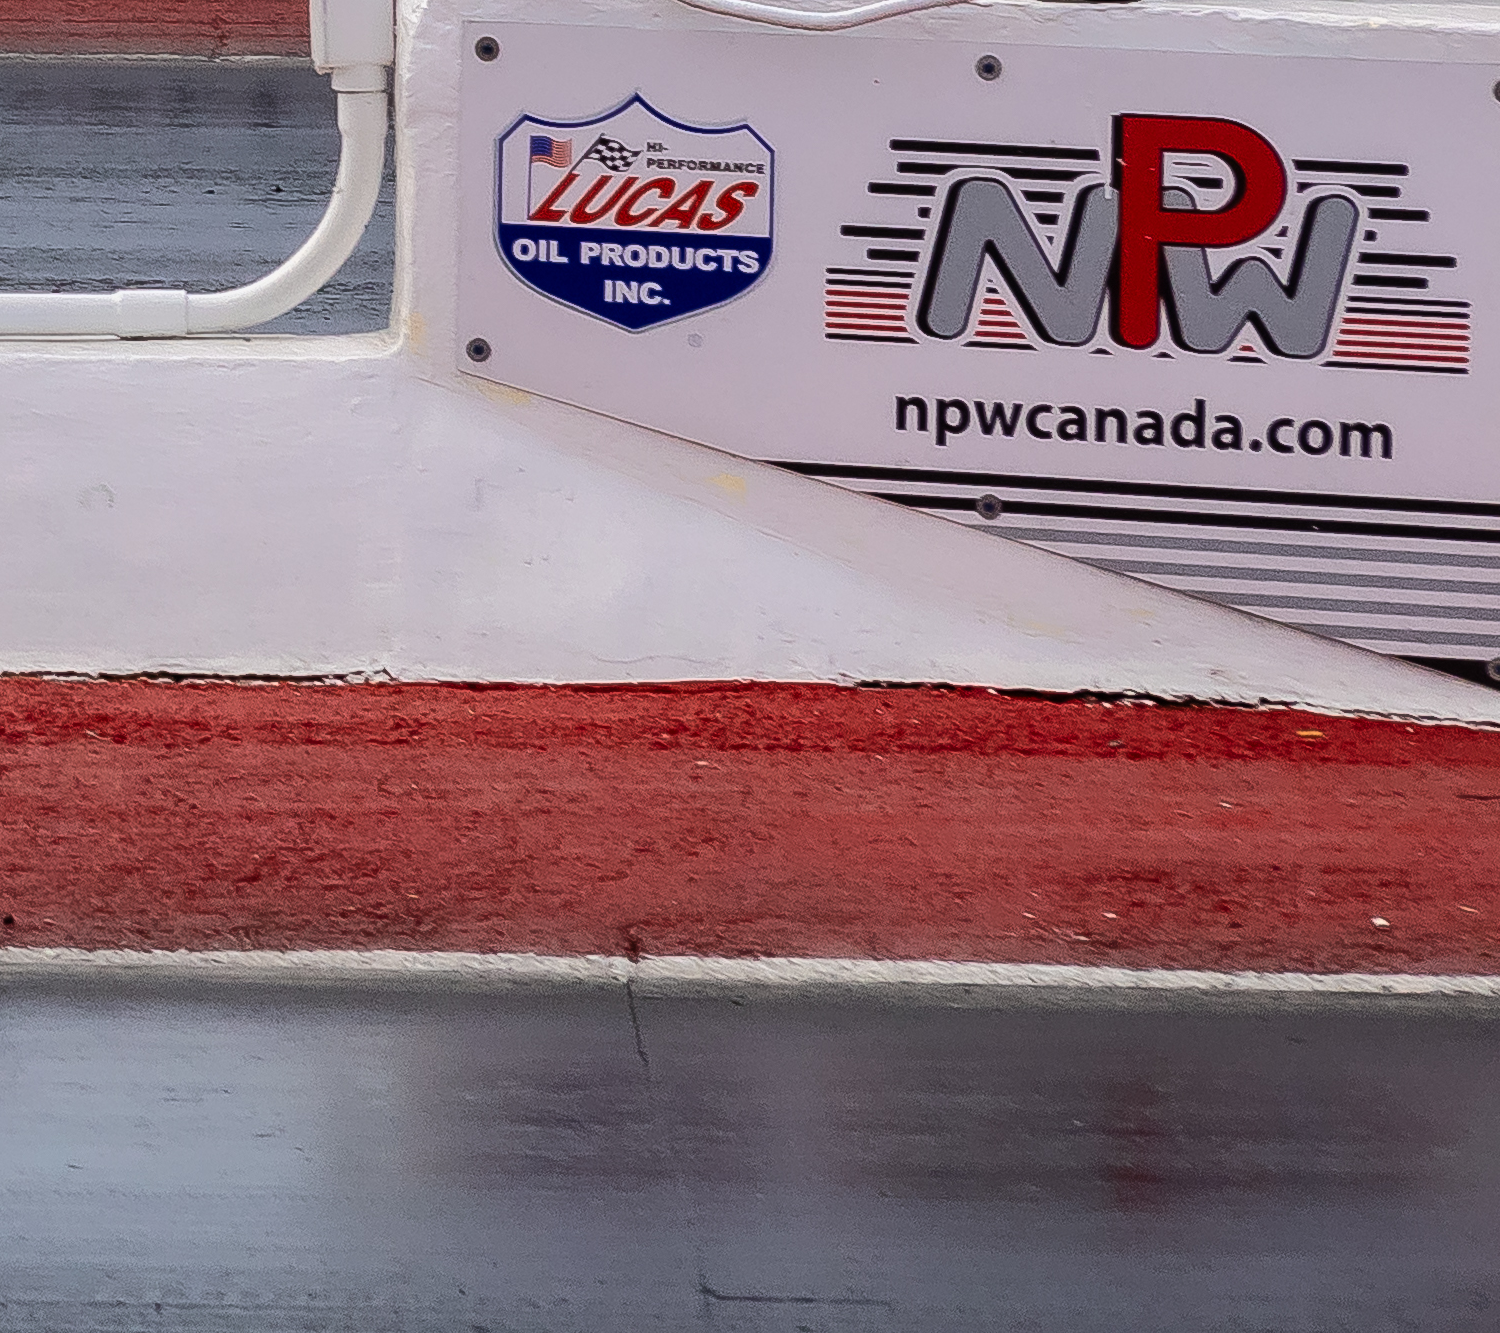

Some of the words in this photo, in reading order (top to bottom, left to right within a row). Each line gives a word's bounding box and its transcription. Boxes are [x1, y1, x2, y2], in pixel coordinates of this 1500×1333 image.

[646, 141, 670, 154] HI-
[646, 157, 766, 175] PERFORMANCE
[527, 172, 760, 232] LUCAS
[914, 112, 1361, 360] NPW
[511, 238, 569, 264] OIL
[579, 240, 760, 274] PRODUCTS
[603, 279, 672, 306] INC.
[894, 394, 1394, 460] npwcanada.com
